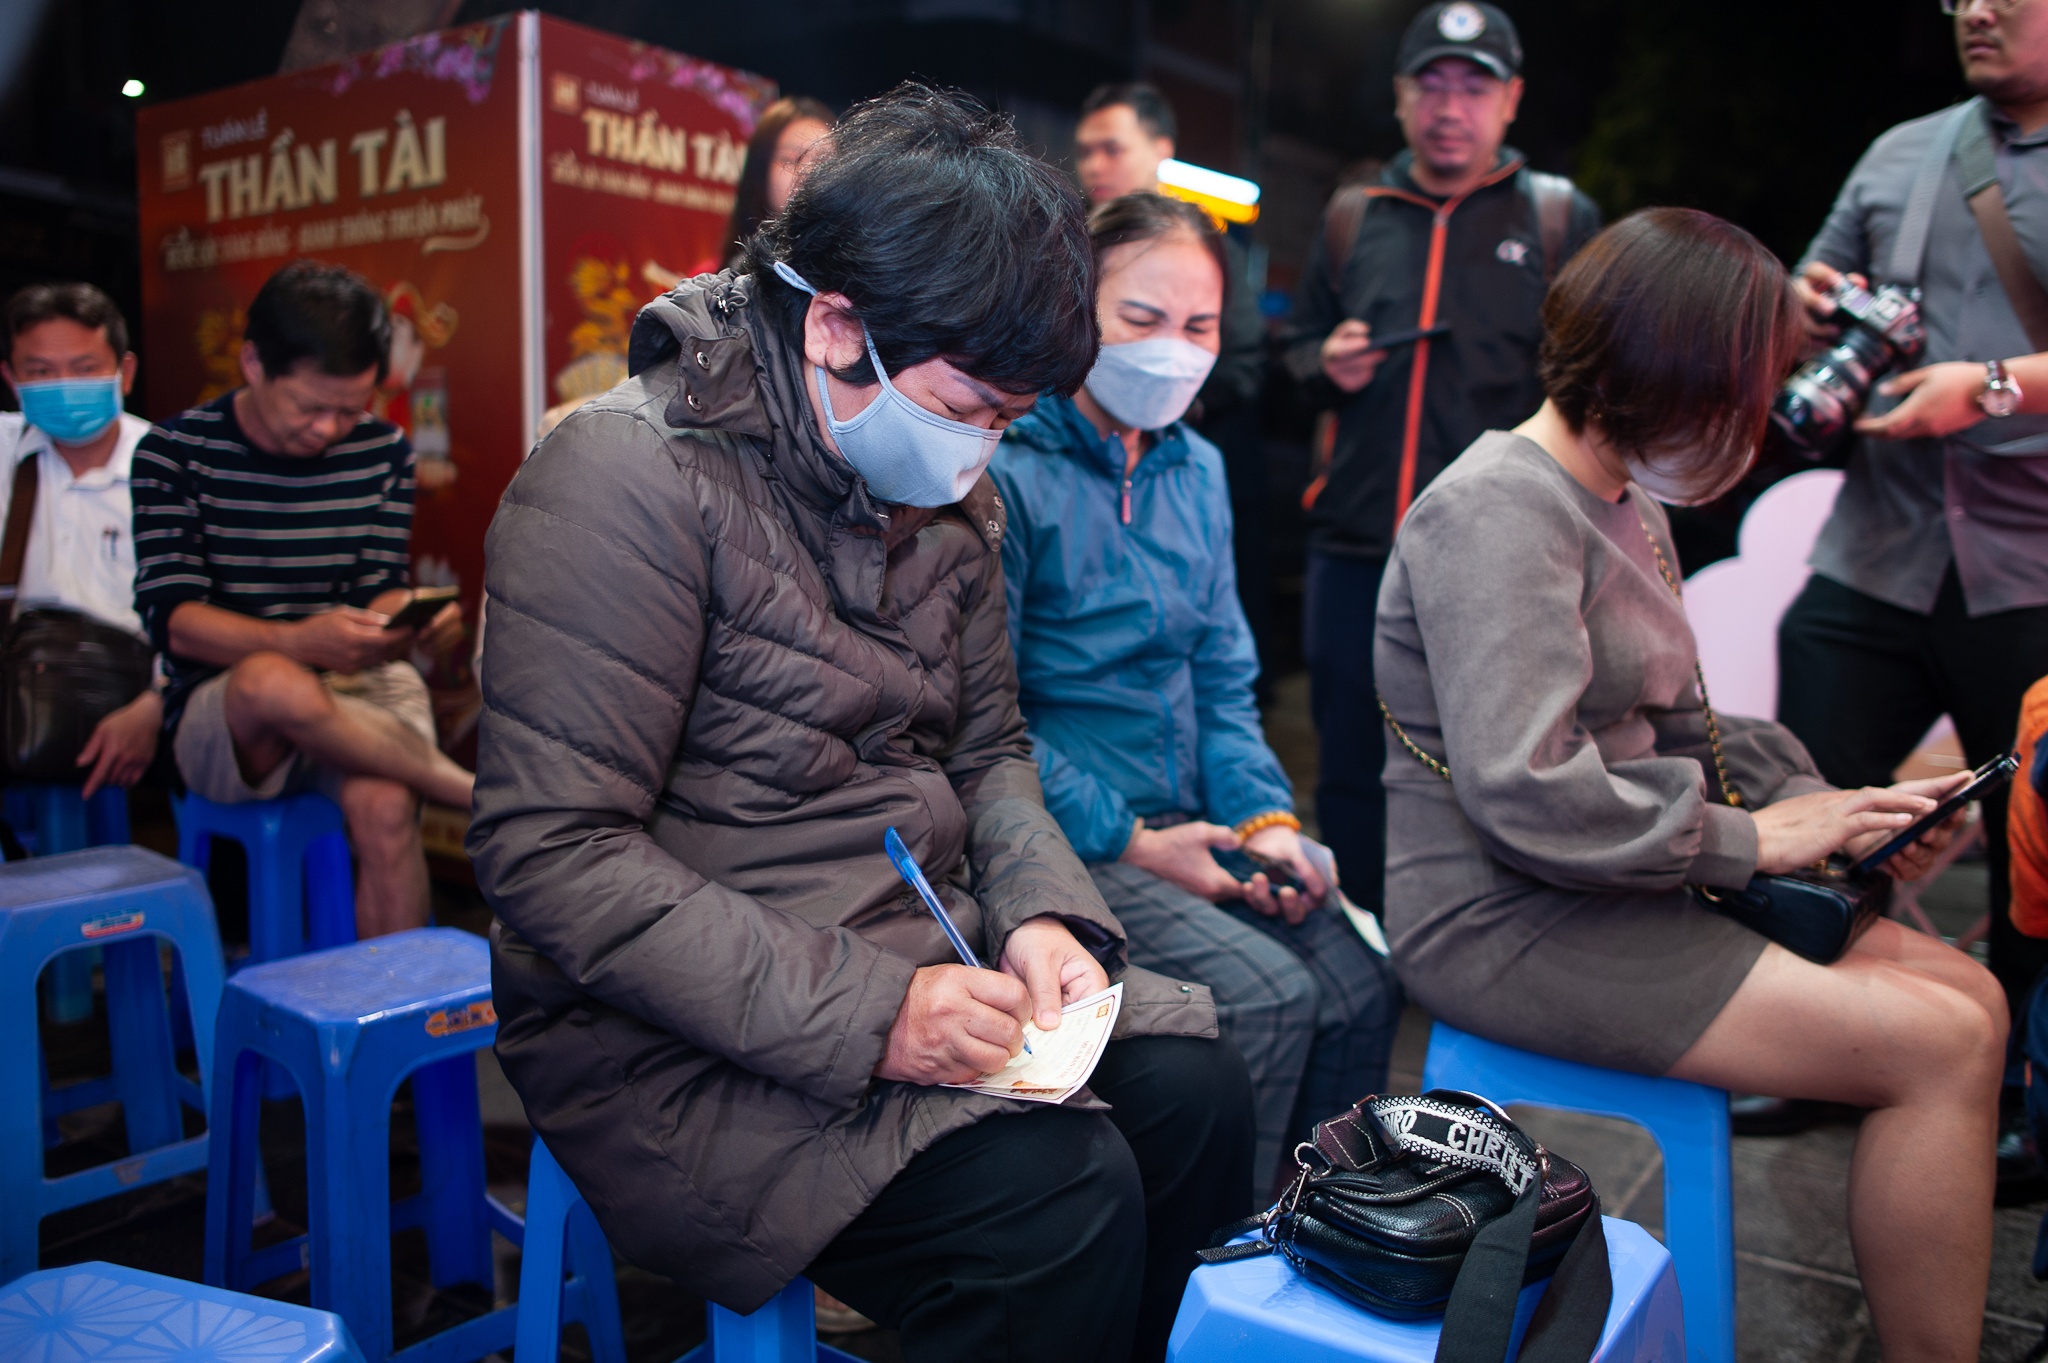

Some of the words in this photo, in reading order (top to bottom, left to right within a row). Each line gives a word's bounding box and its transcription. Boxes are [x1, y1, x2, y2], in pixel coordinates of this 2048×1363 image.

[198, 126, 338, 224] THẦN
[350, 108, 447, 199] TÀI
[581, 106, 688, 175] THẦN
